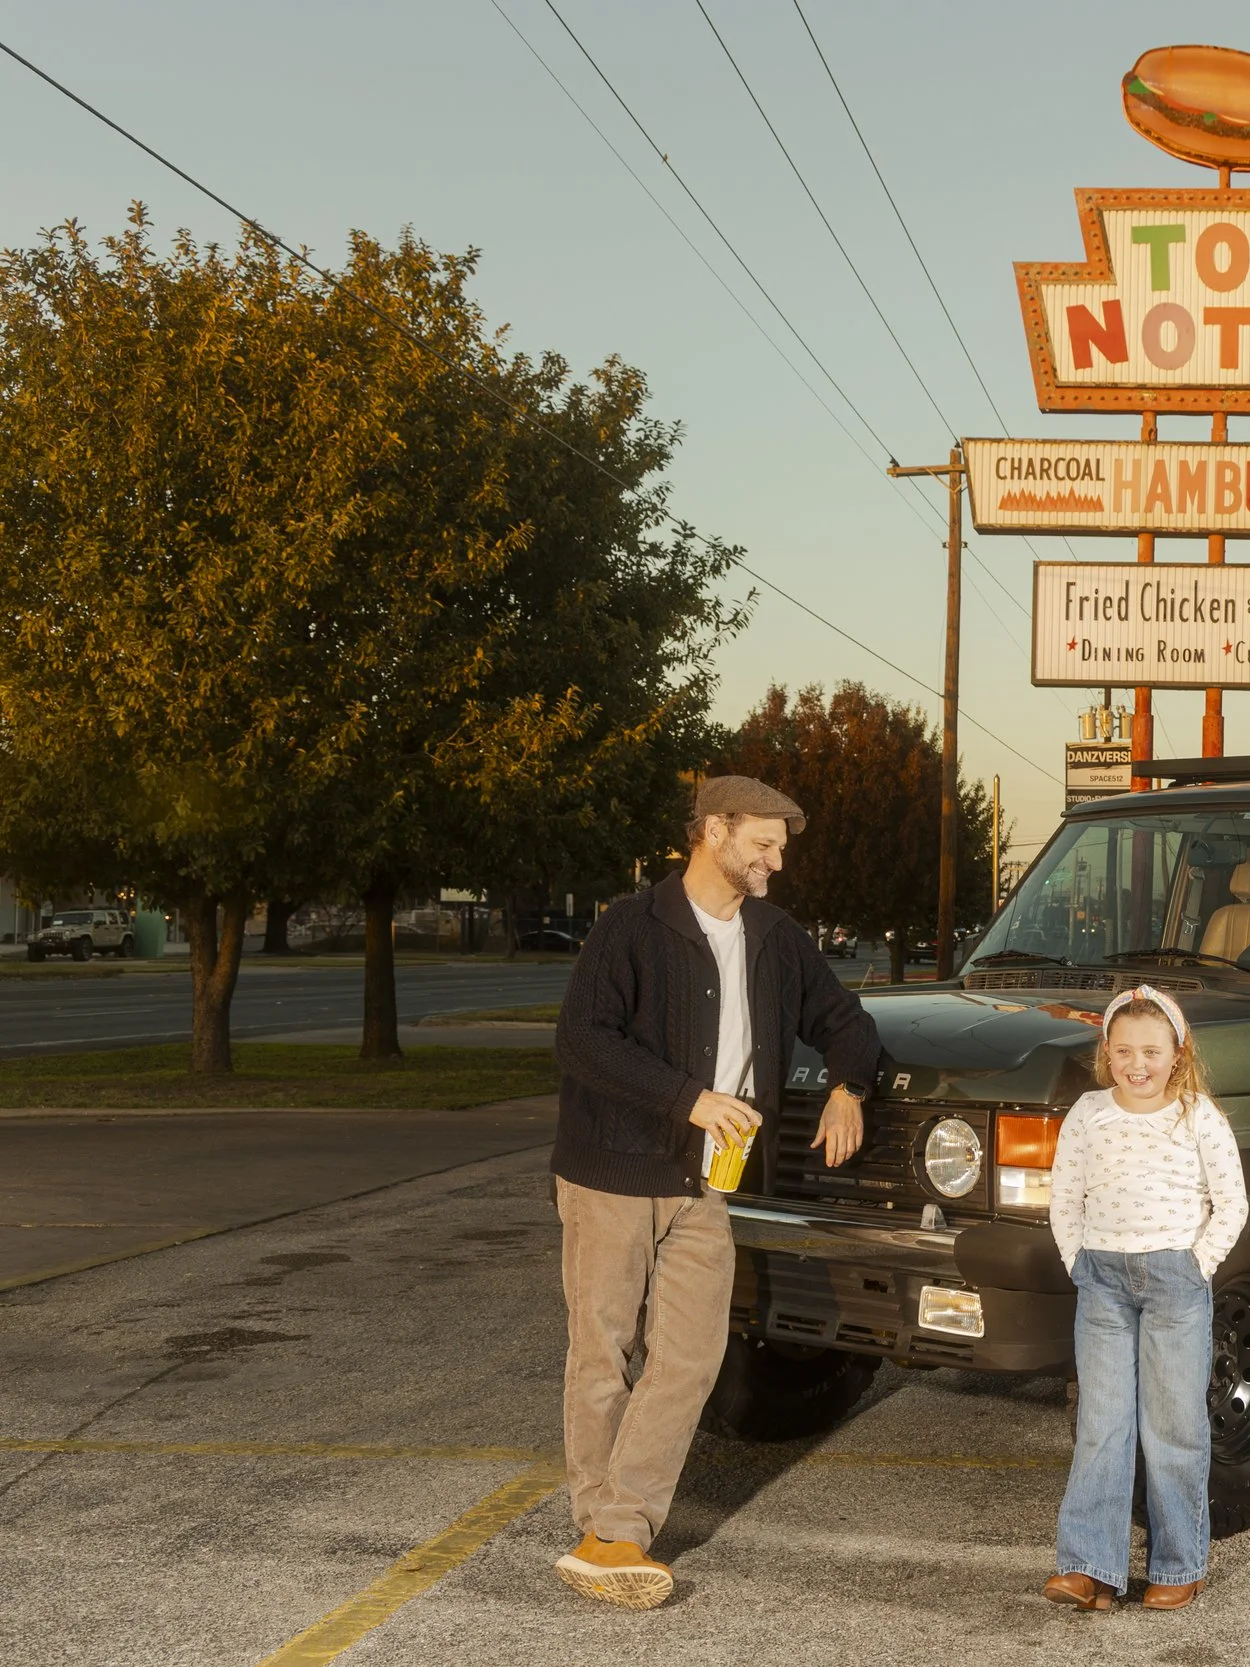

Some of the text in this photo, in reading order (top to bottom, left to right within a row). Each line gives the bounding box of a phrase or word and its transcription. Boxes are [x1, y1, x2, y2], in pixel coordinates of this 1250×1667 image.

[995, 456, 1106, 482] CHARCOAL
[1065, 580, 1130, 623] Fried
[1140, 580, 1236, 624] Chicken
[1081, 639, 1145, 663] DINING
[1157, 640, 1206, 663] ROOM
[1067, 751, 1131, 763] DANZVERSI
[1089, 775, 1123, 783] SPACE512
